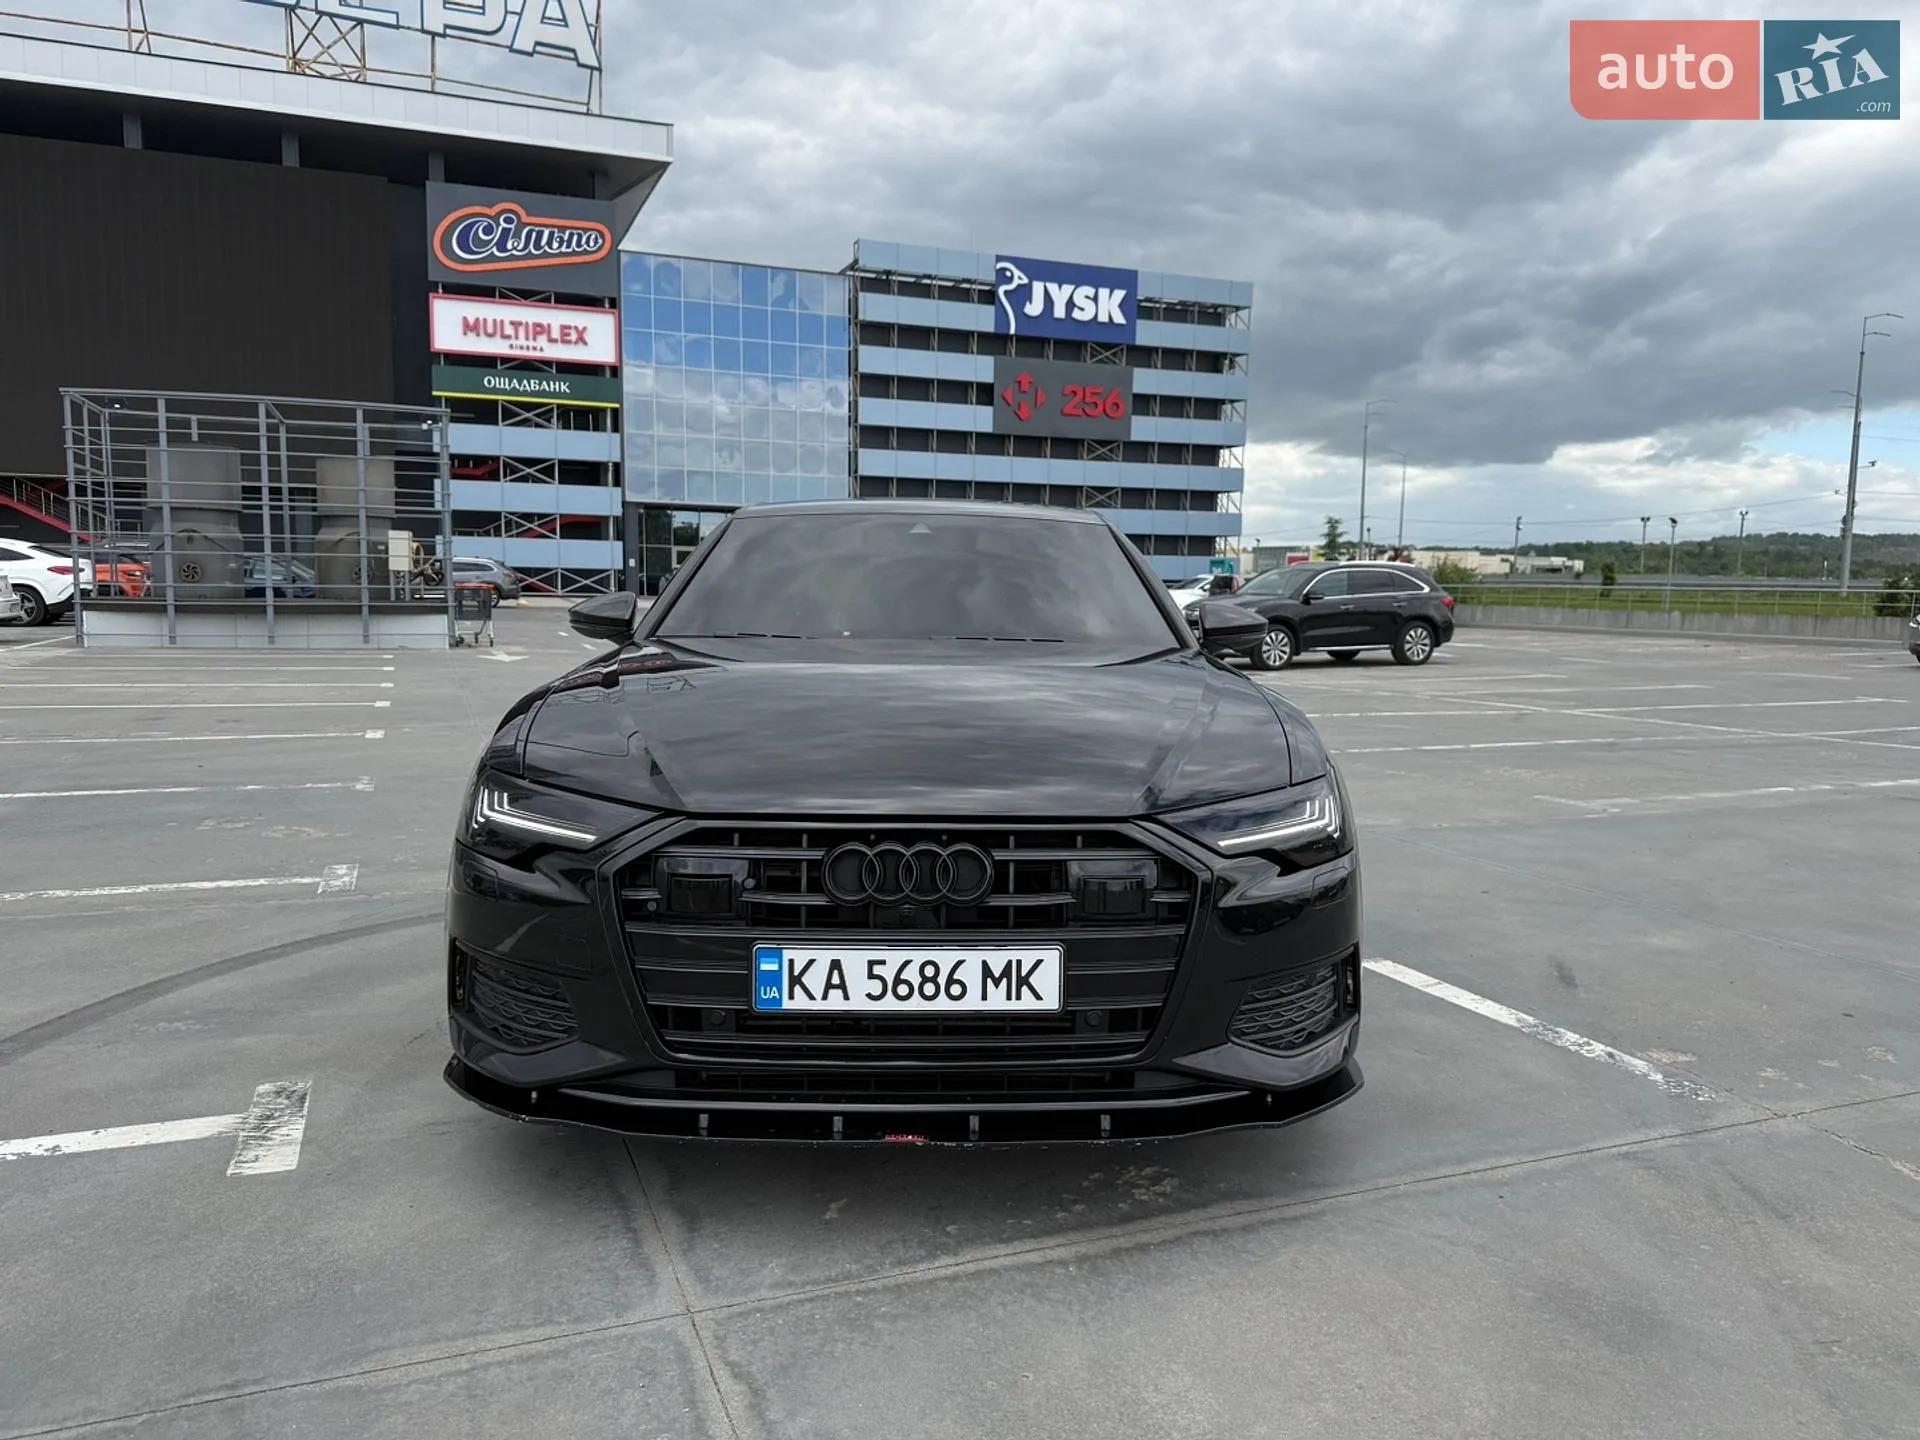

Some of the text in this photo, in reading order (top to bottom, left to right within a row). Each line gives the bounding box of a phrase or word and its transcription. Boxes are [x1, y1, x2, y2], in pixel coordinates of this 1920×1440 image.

[452, 213, 603, 260] Сільпо
[1022, 280, 1128, 325] JYSK
[461, 316, 588, 346] MULTIPLEX
[483, 375, 571, 394] ОЩАДБАНК
[1061, 384, 1126, 420] 256
[760, 986, 780, 999] UA
[787, 958, 1045, 1002] KA 5686 MK
